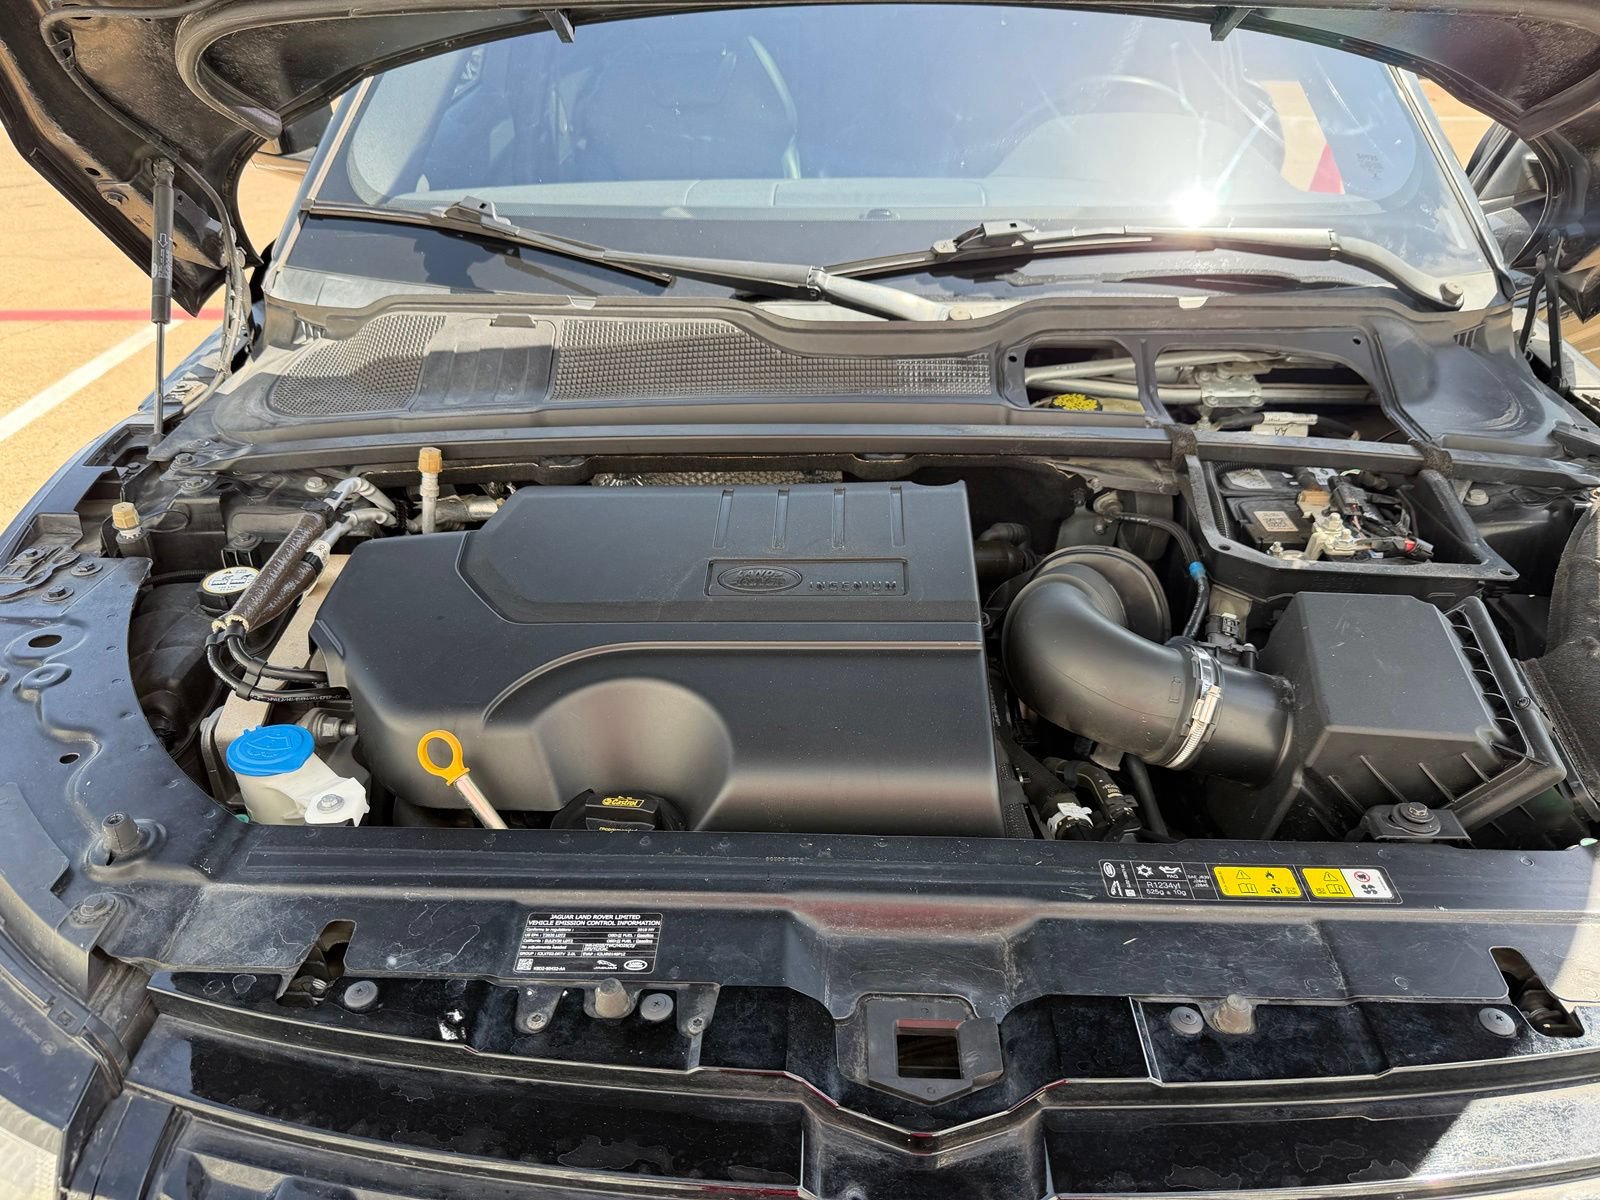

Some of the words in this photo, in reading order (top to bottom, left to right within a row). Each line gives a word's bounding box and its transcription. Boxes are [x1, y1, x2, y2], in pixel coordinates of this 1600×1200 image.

[737, 569, 776, 577] LAND
[809, 581, 897, 592] INGENIUM
[1146, 881, 1181, 890] R1234yf
[1146, 888, 1165, 896] 525g
